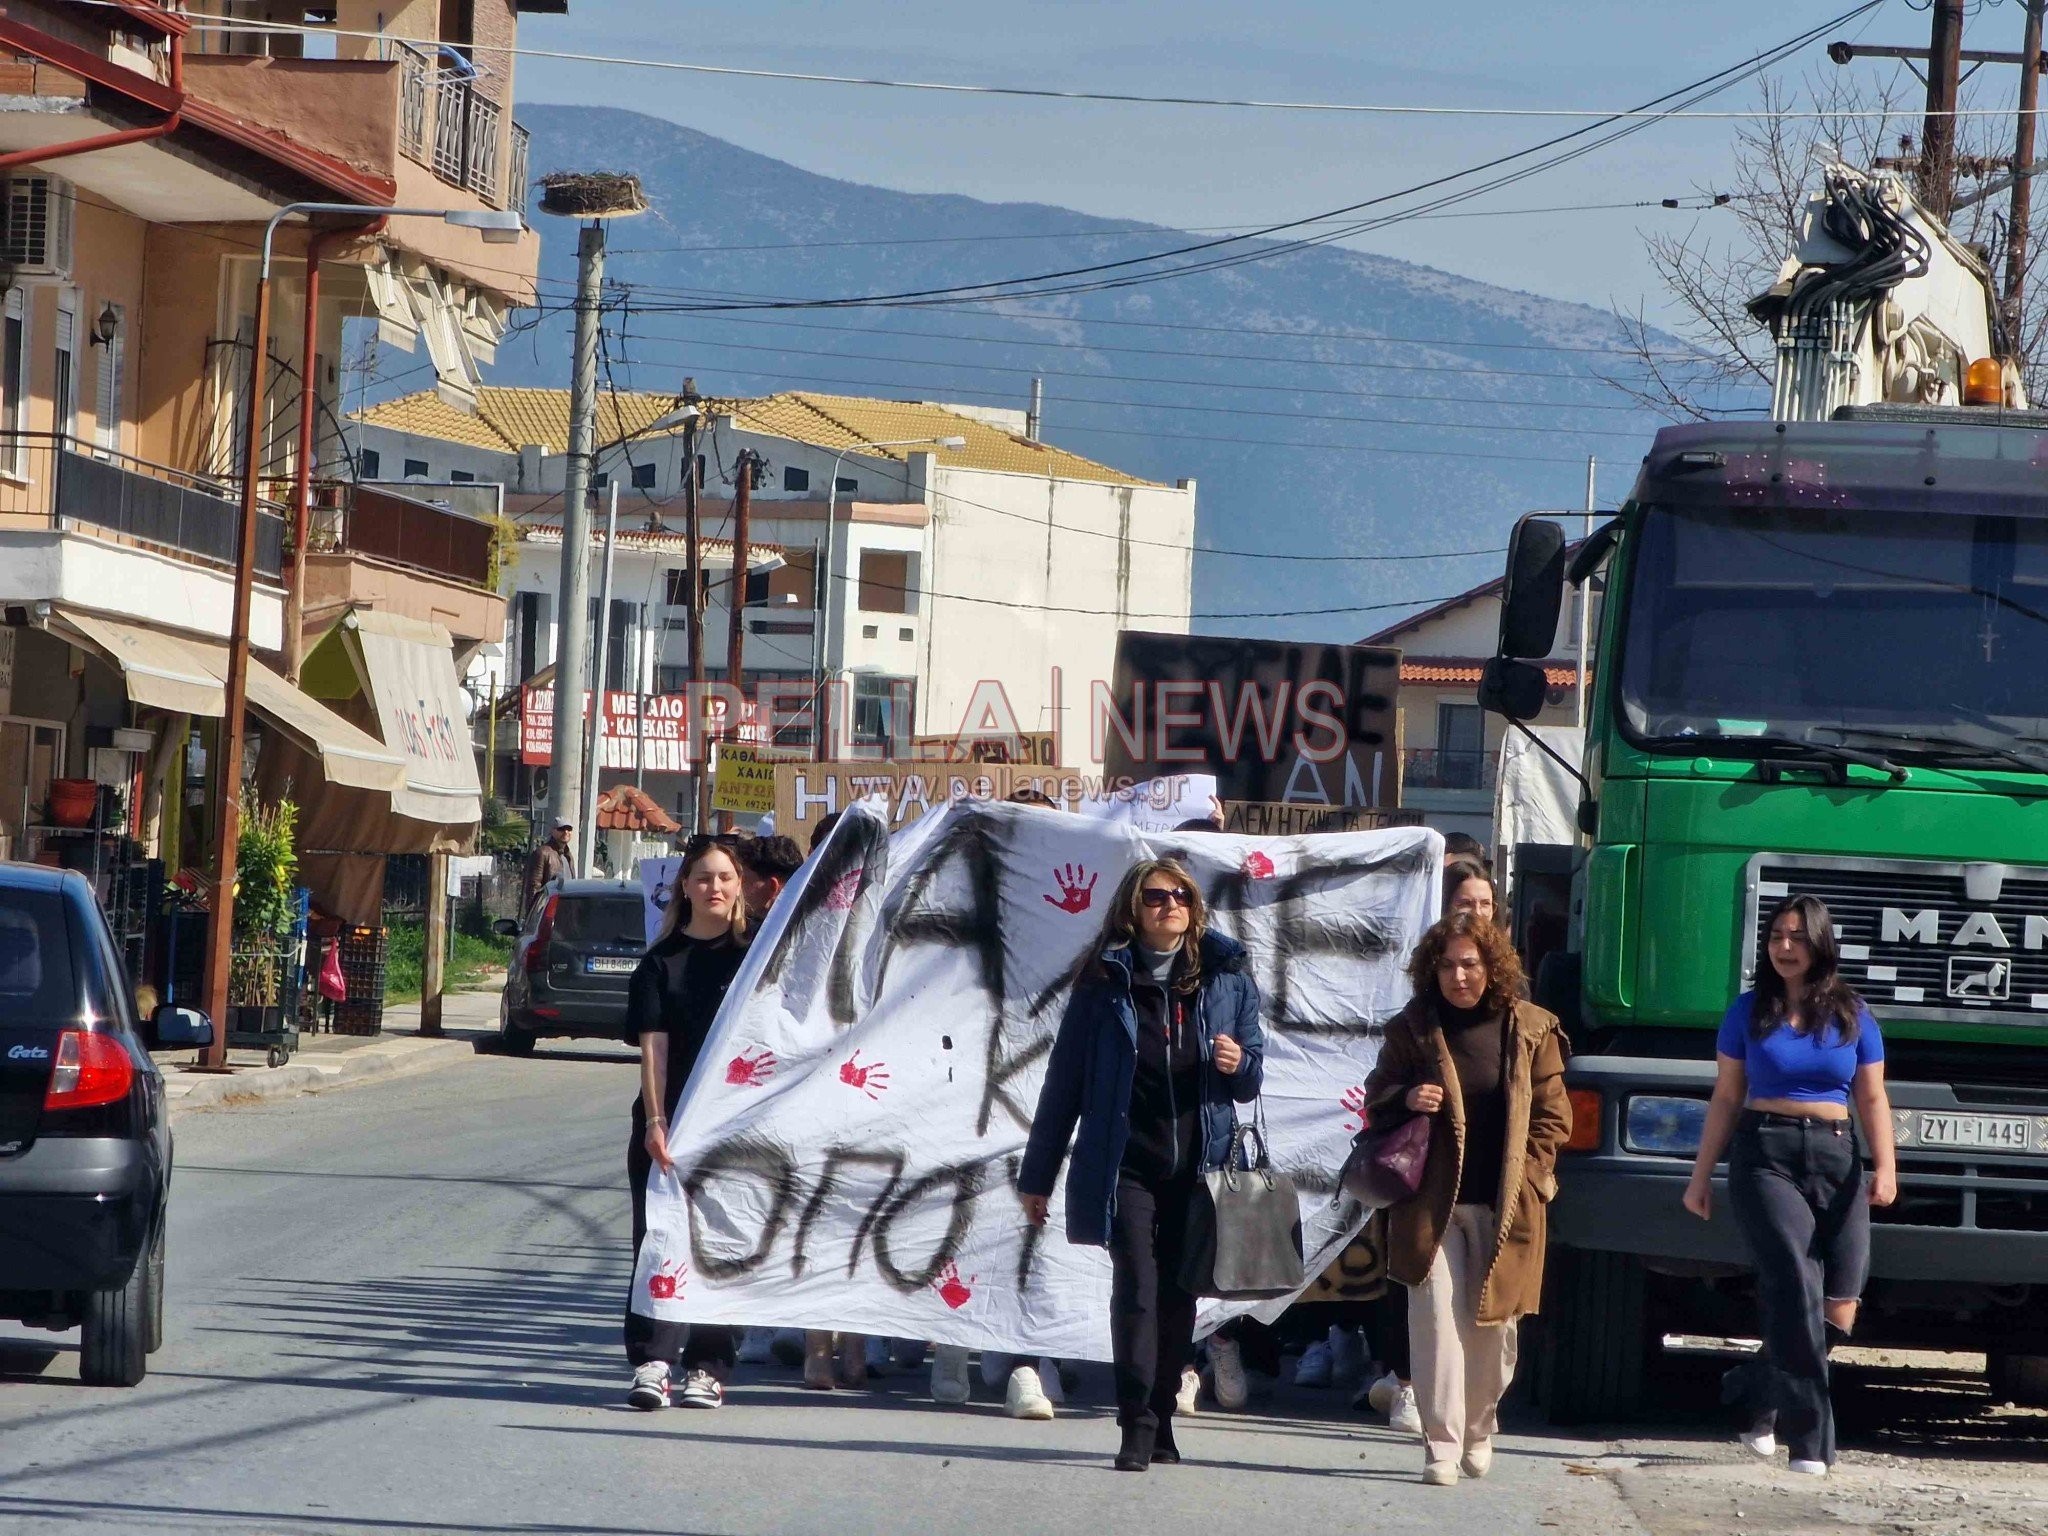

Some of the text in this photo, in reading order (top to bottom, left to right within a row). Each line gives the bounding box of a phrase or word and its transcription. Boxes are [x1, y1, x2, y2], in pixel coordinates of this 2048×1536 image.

[612, 694, 684, 719] ΜΕΑΛΟ
[616, 716, 679, 739] ΚΑΕΚΛΕΣ
[7, 1044, 48, 1059] Getz
